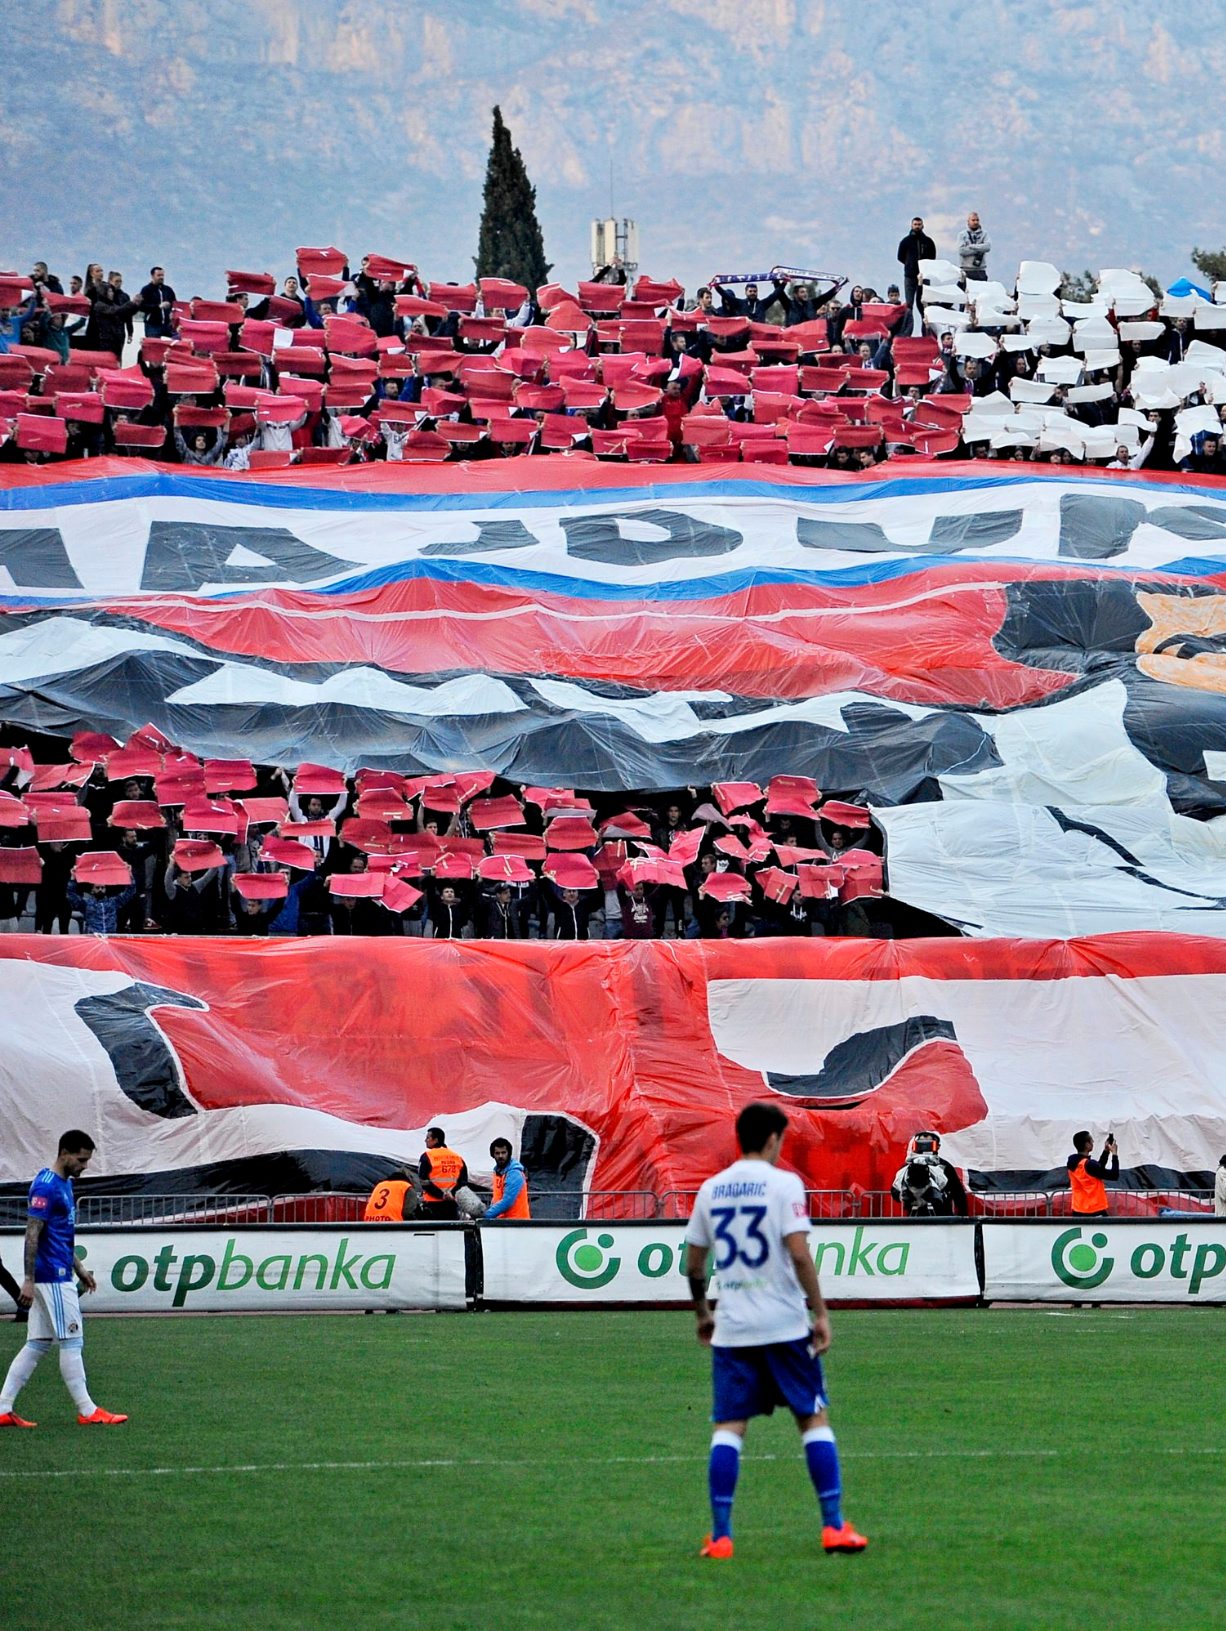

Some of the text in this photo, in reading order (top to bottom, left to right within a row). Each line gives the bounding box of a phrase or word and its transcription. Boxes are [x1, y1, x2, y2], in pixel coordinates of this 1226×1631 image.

[374, 1188, 390, 1209] 3
[710, 1205, 769, 1270] 33
[110, 1238, 396, 1307] otpbanka
